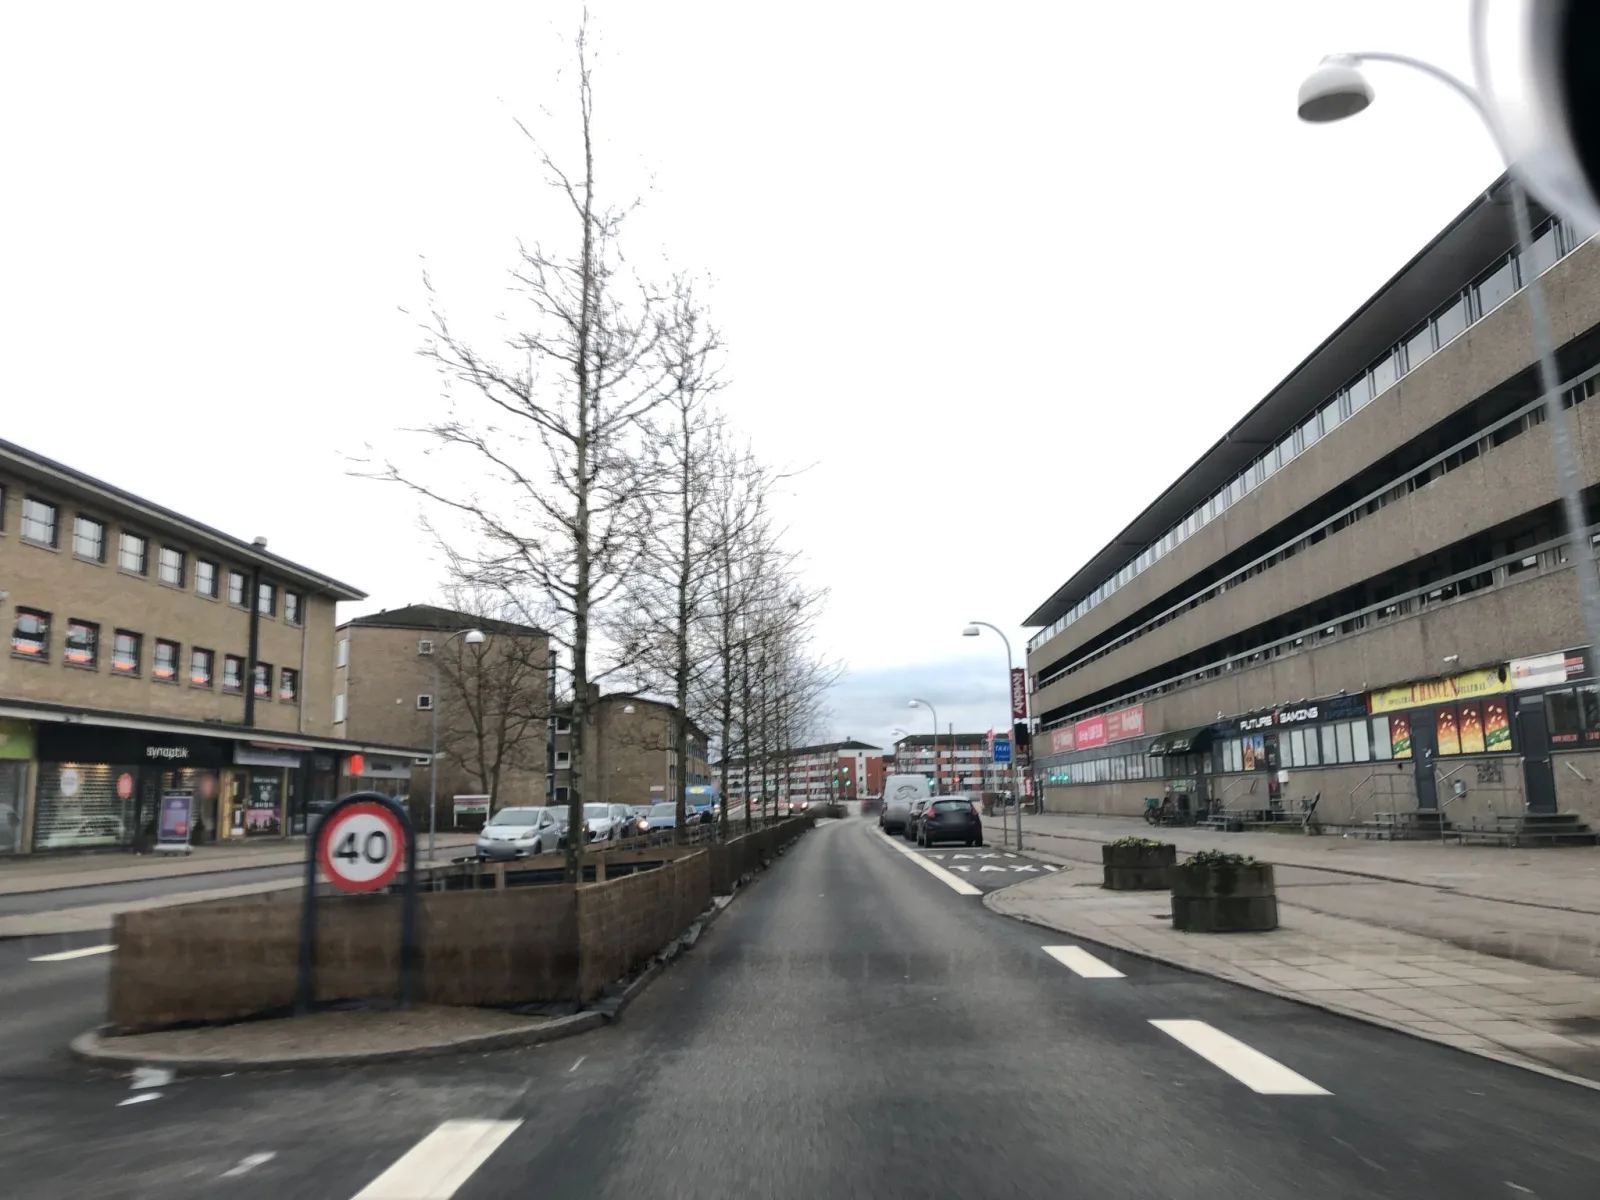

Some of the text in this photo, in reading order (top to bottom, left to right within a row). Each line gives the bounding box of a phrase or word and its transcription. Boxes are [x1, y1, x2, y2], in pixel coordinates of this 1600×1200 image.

[1240, 716, 1273, 731] FUTURE
[1280, 707, 1319, 724] GAMING
[146, 746, 190, 759] synoptik
[332, 830, 387, 865] 40
[948, 864, 1059, 872] TAXI
